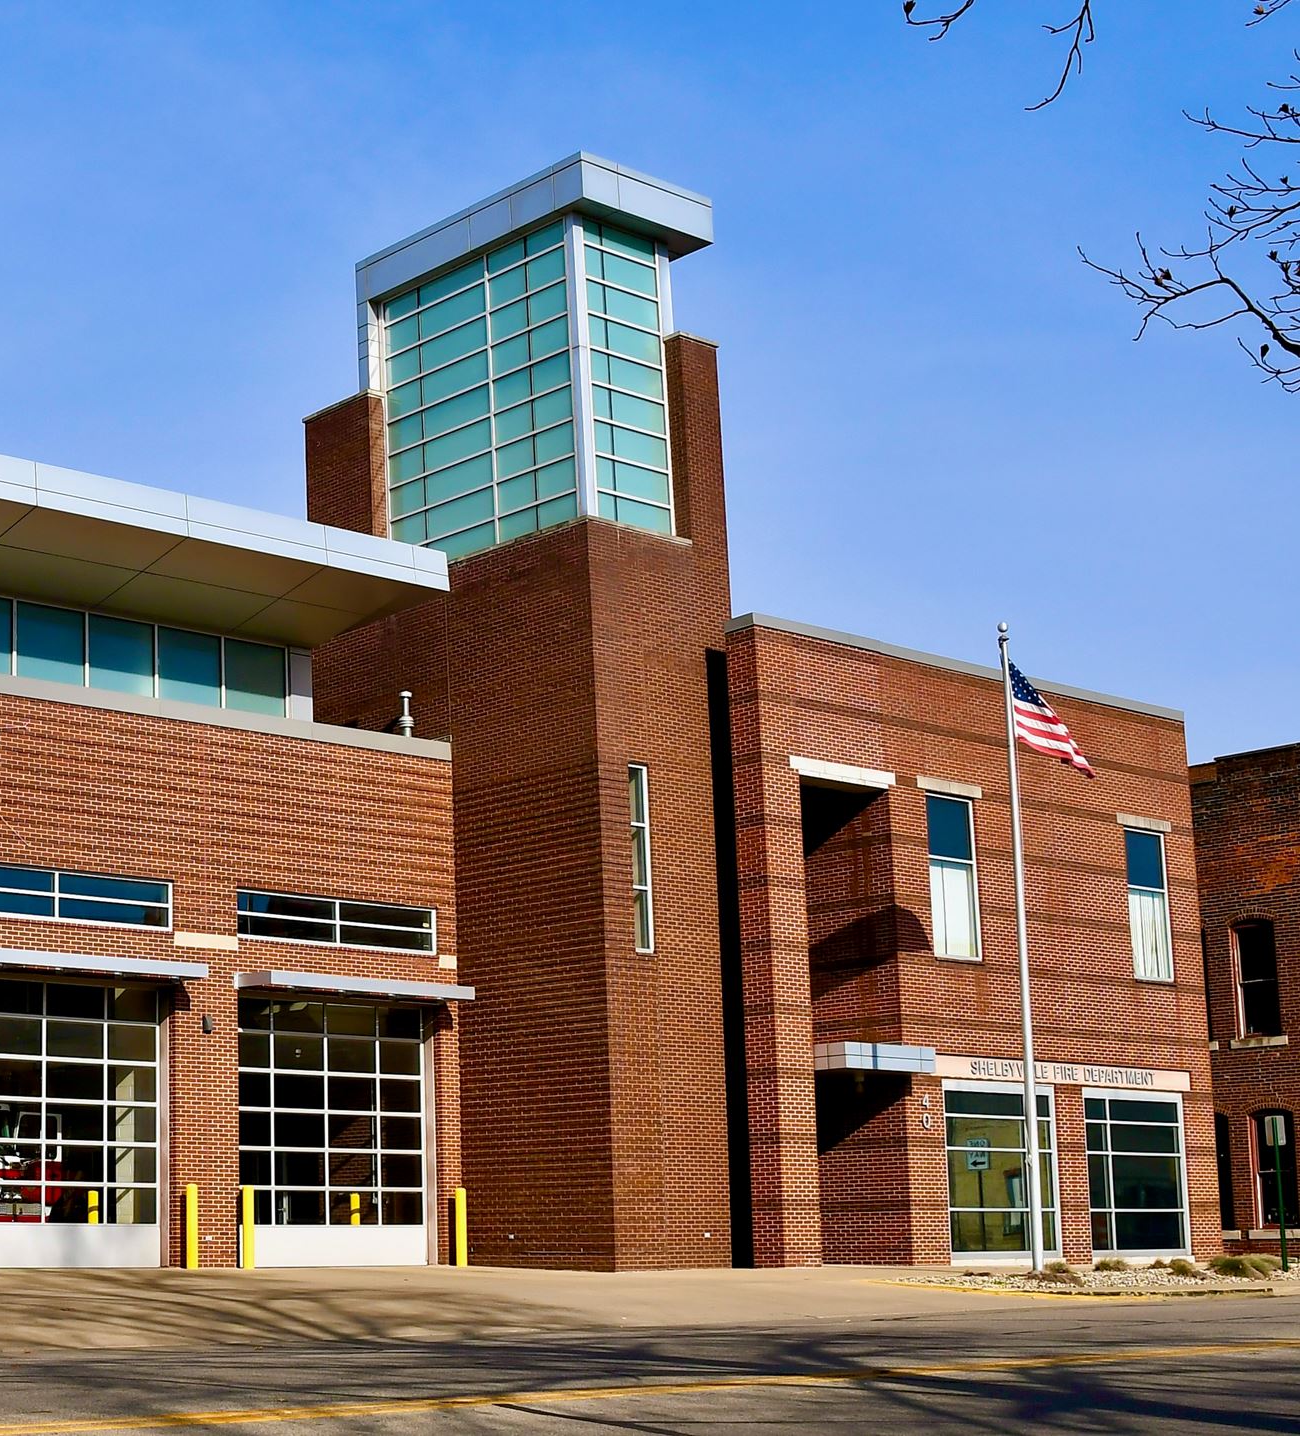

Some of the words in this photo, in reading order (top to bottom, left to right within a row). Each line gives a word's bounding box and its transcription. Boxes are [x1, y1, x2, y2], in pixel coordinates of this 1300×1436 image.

[970, 1060, 1048, 1080] SHELBYVLE
[1053, 1065, 1079, 1081] FIRE
[1083, 1067, 1155, 1086] DEPARTMENT
